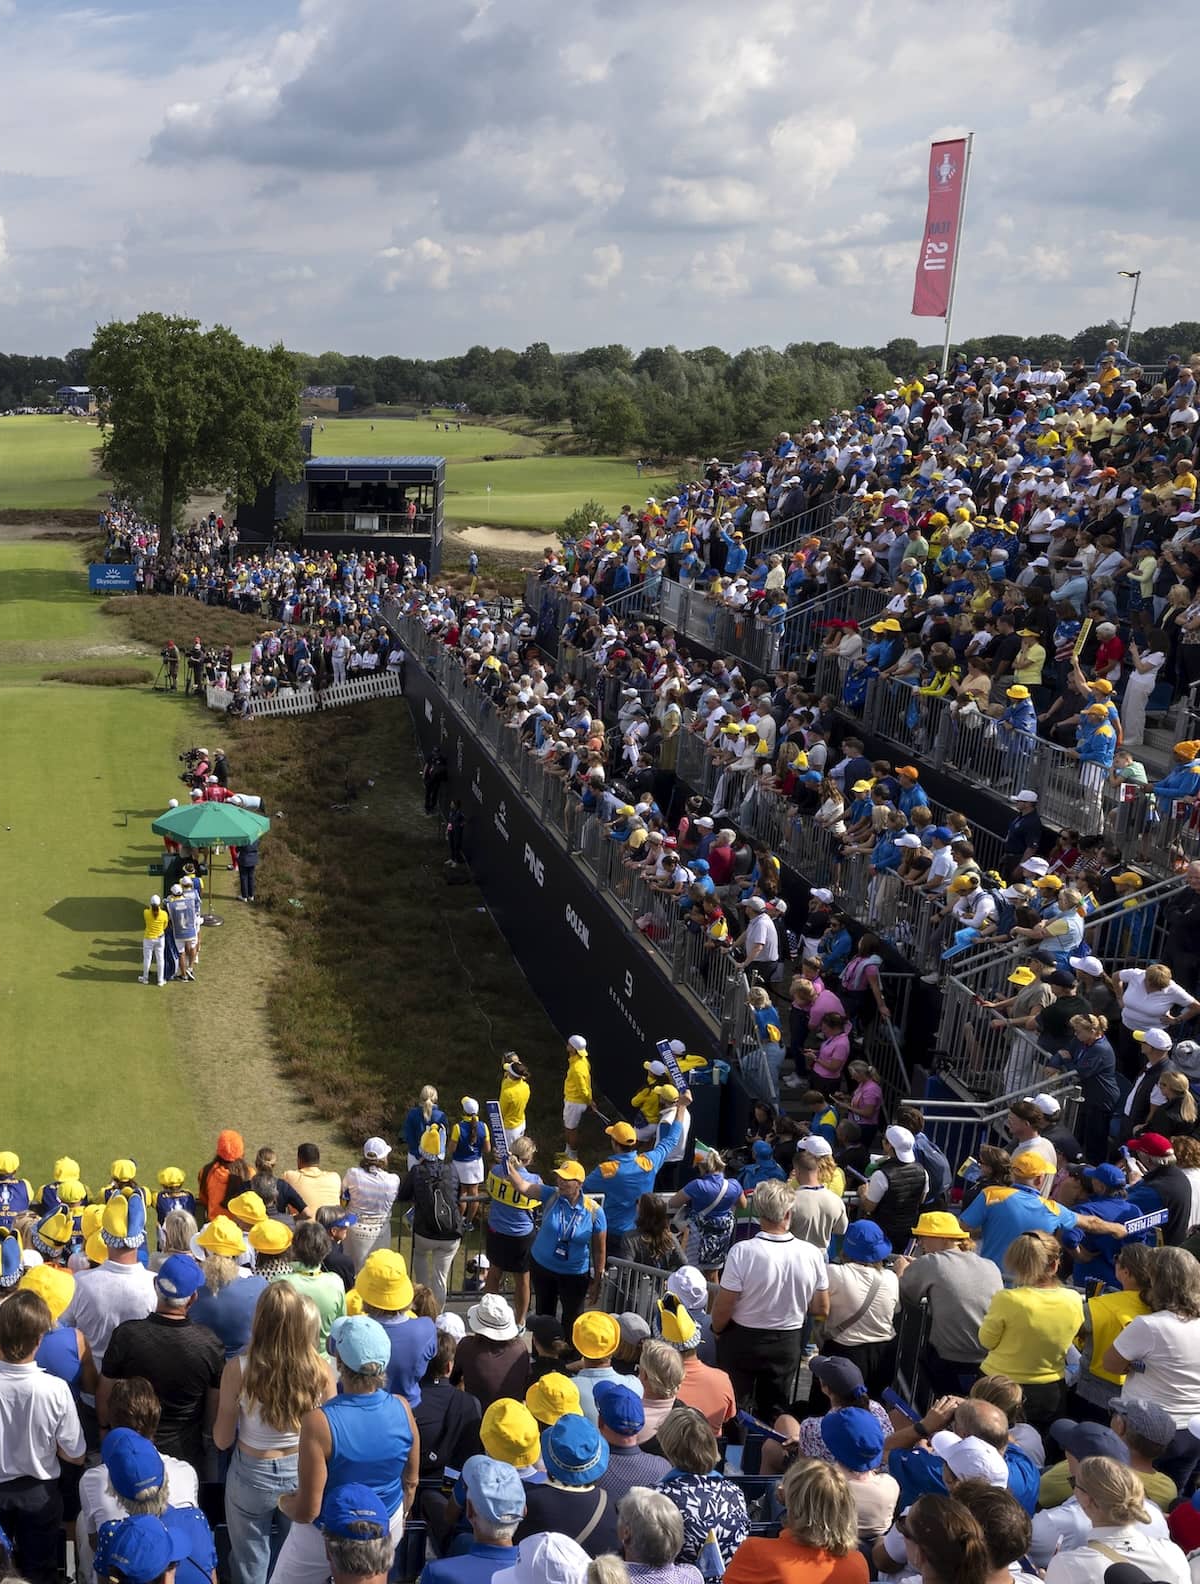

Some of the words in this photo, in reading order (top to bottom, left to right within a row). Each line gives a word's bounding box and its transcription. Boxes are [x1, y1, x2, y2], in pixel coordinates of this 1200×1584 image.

[524, 842, 545, 888] PING
[662, 1049, 678, 1069] QUIET
[1128, 1219, 1146, 1233] PLEASE
[1147, 1214, 1161, 1227] QUIET
